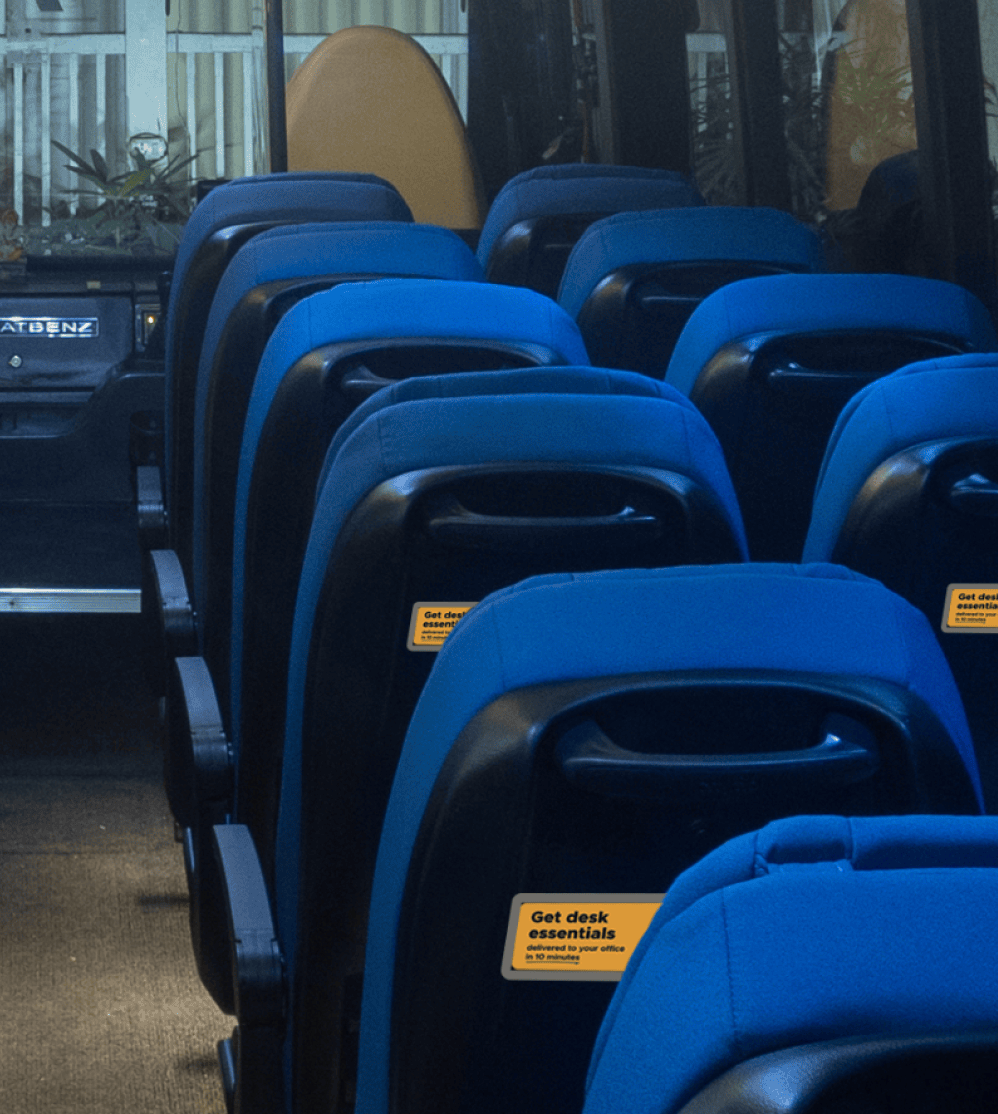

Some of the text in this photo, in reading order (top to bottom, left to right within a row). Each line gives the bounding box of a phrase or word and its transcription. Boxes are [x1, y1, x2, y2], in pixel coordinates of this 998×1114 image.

[958, 593, 976, 601] Get
[424, 611, 442, 619] Get
[423, 620, 459, 628] essent
[531, 911, 609, 923] Get desk
[528, 926, 616, 939] essentials
[526, 944, 566, 952] delivered
[579, 945, 599, 953] your
